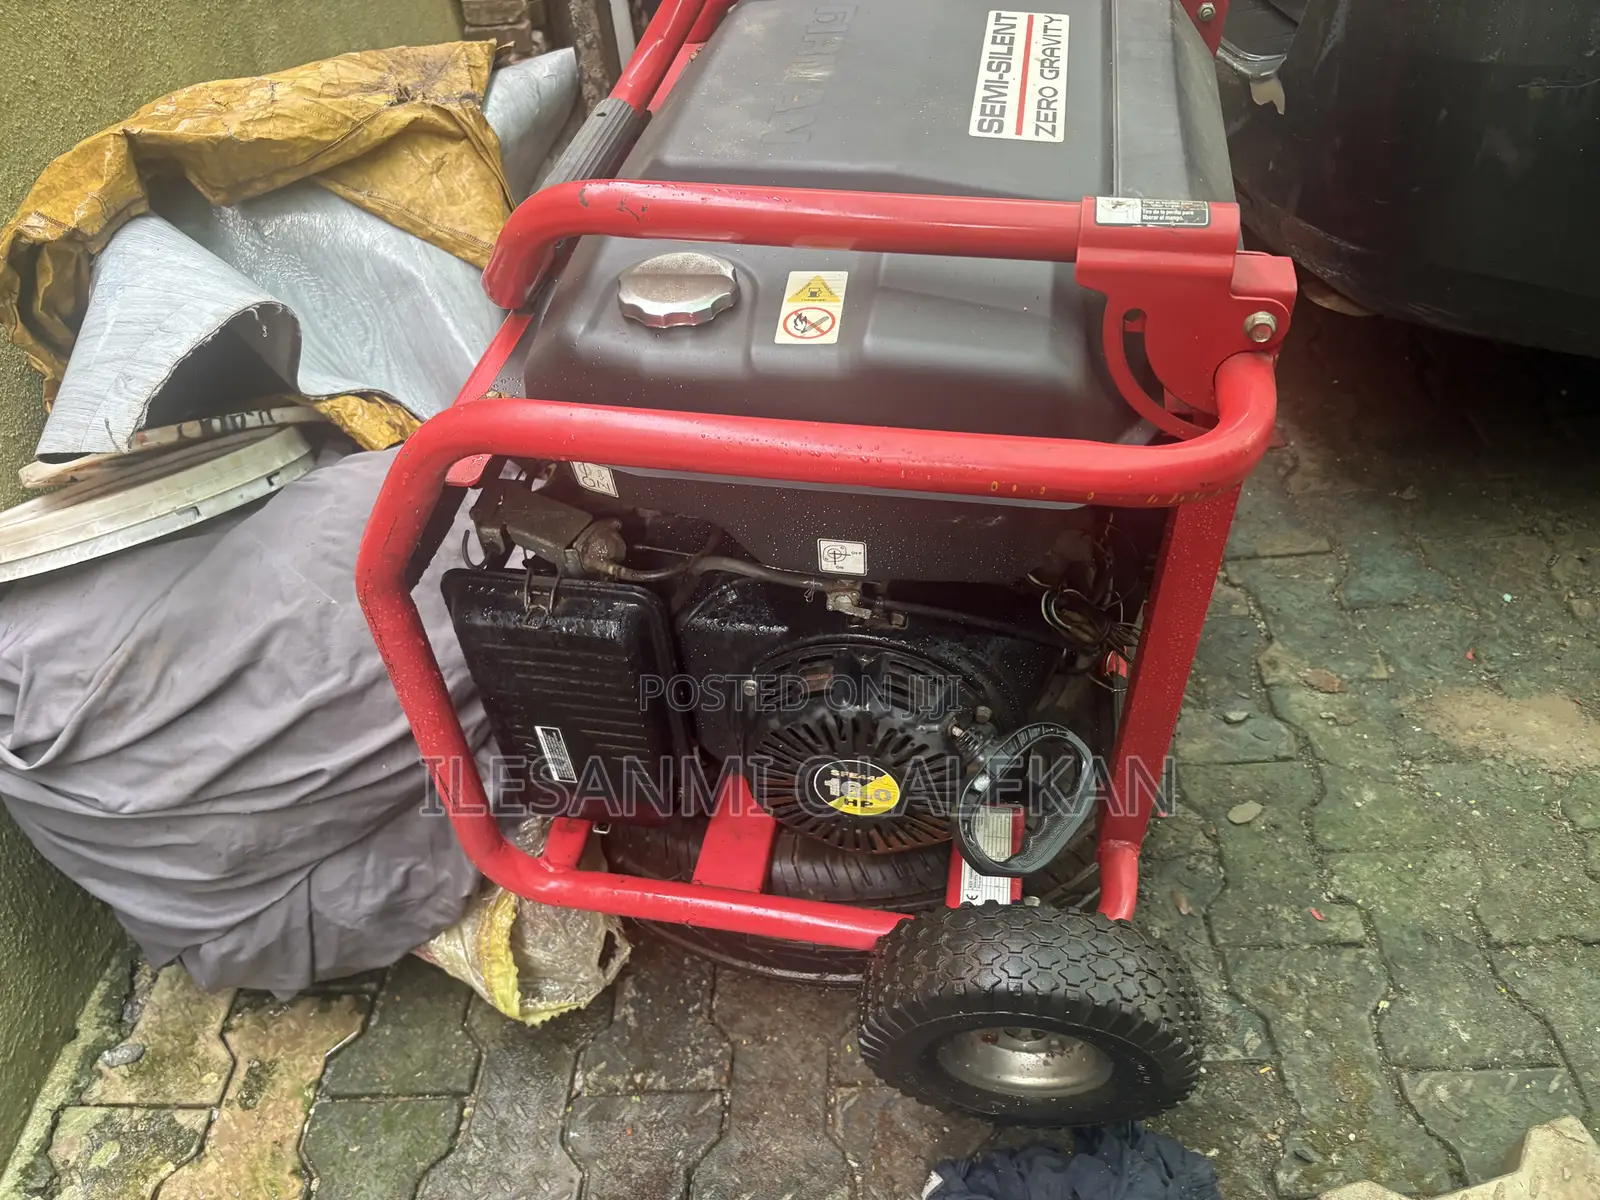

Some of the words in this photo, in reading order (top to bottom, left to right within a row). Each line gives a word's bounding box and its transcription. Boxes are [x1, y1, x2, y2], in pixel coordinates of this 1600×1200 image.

[977, 12, 1018, 134] SEMI-SILENT
[1039, 15, 1062, 80] GRAVITY
[1034, 86, 1058, 138] ZERO
[582, 476, 611, 492] ON
[844, 798, 874, 808] HP
